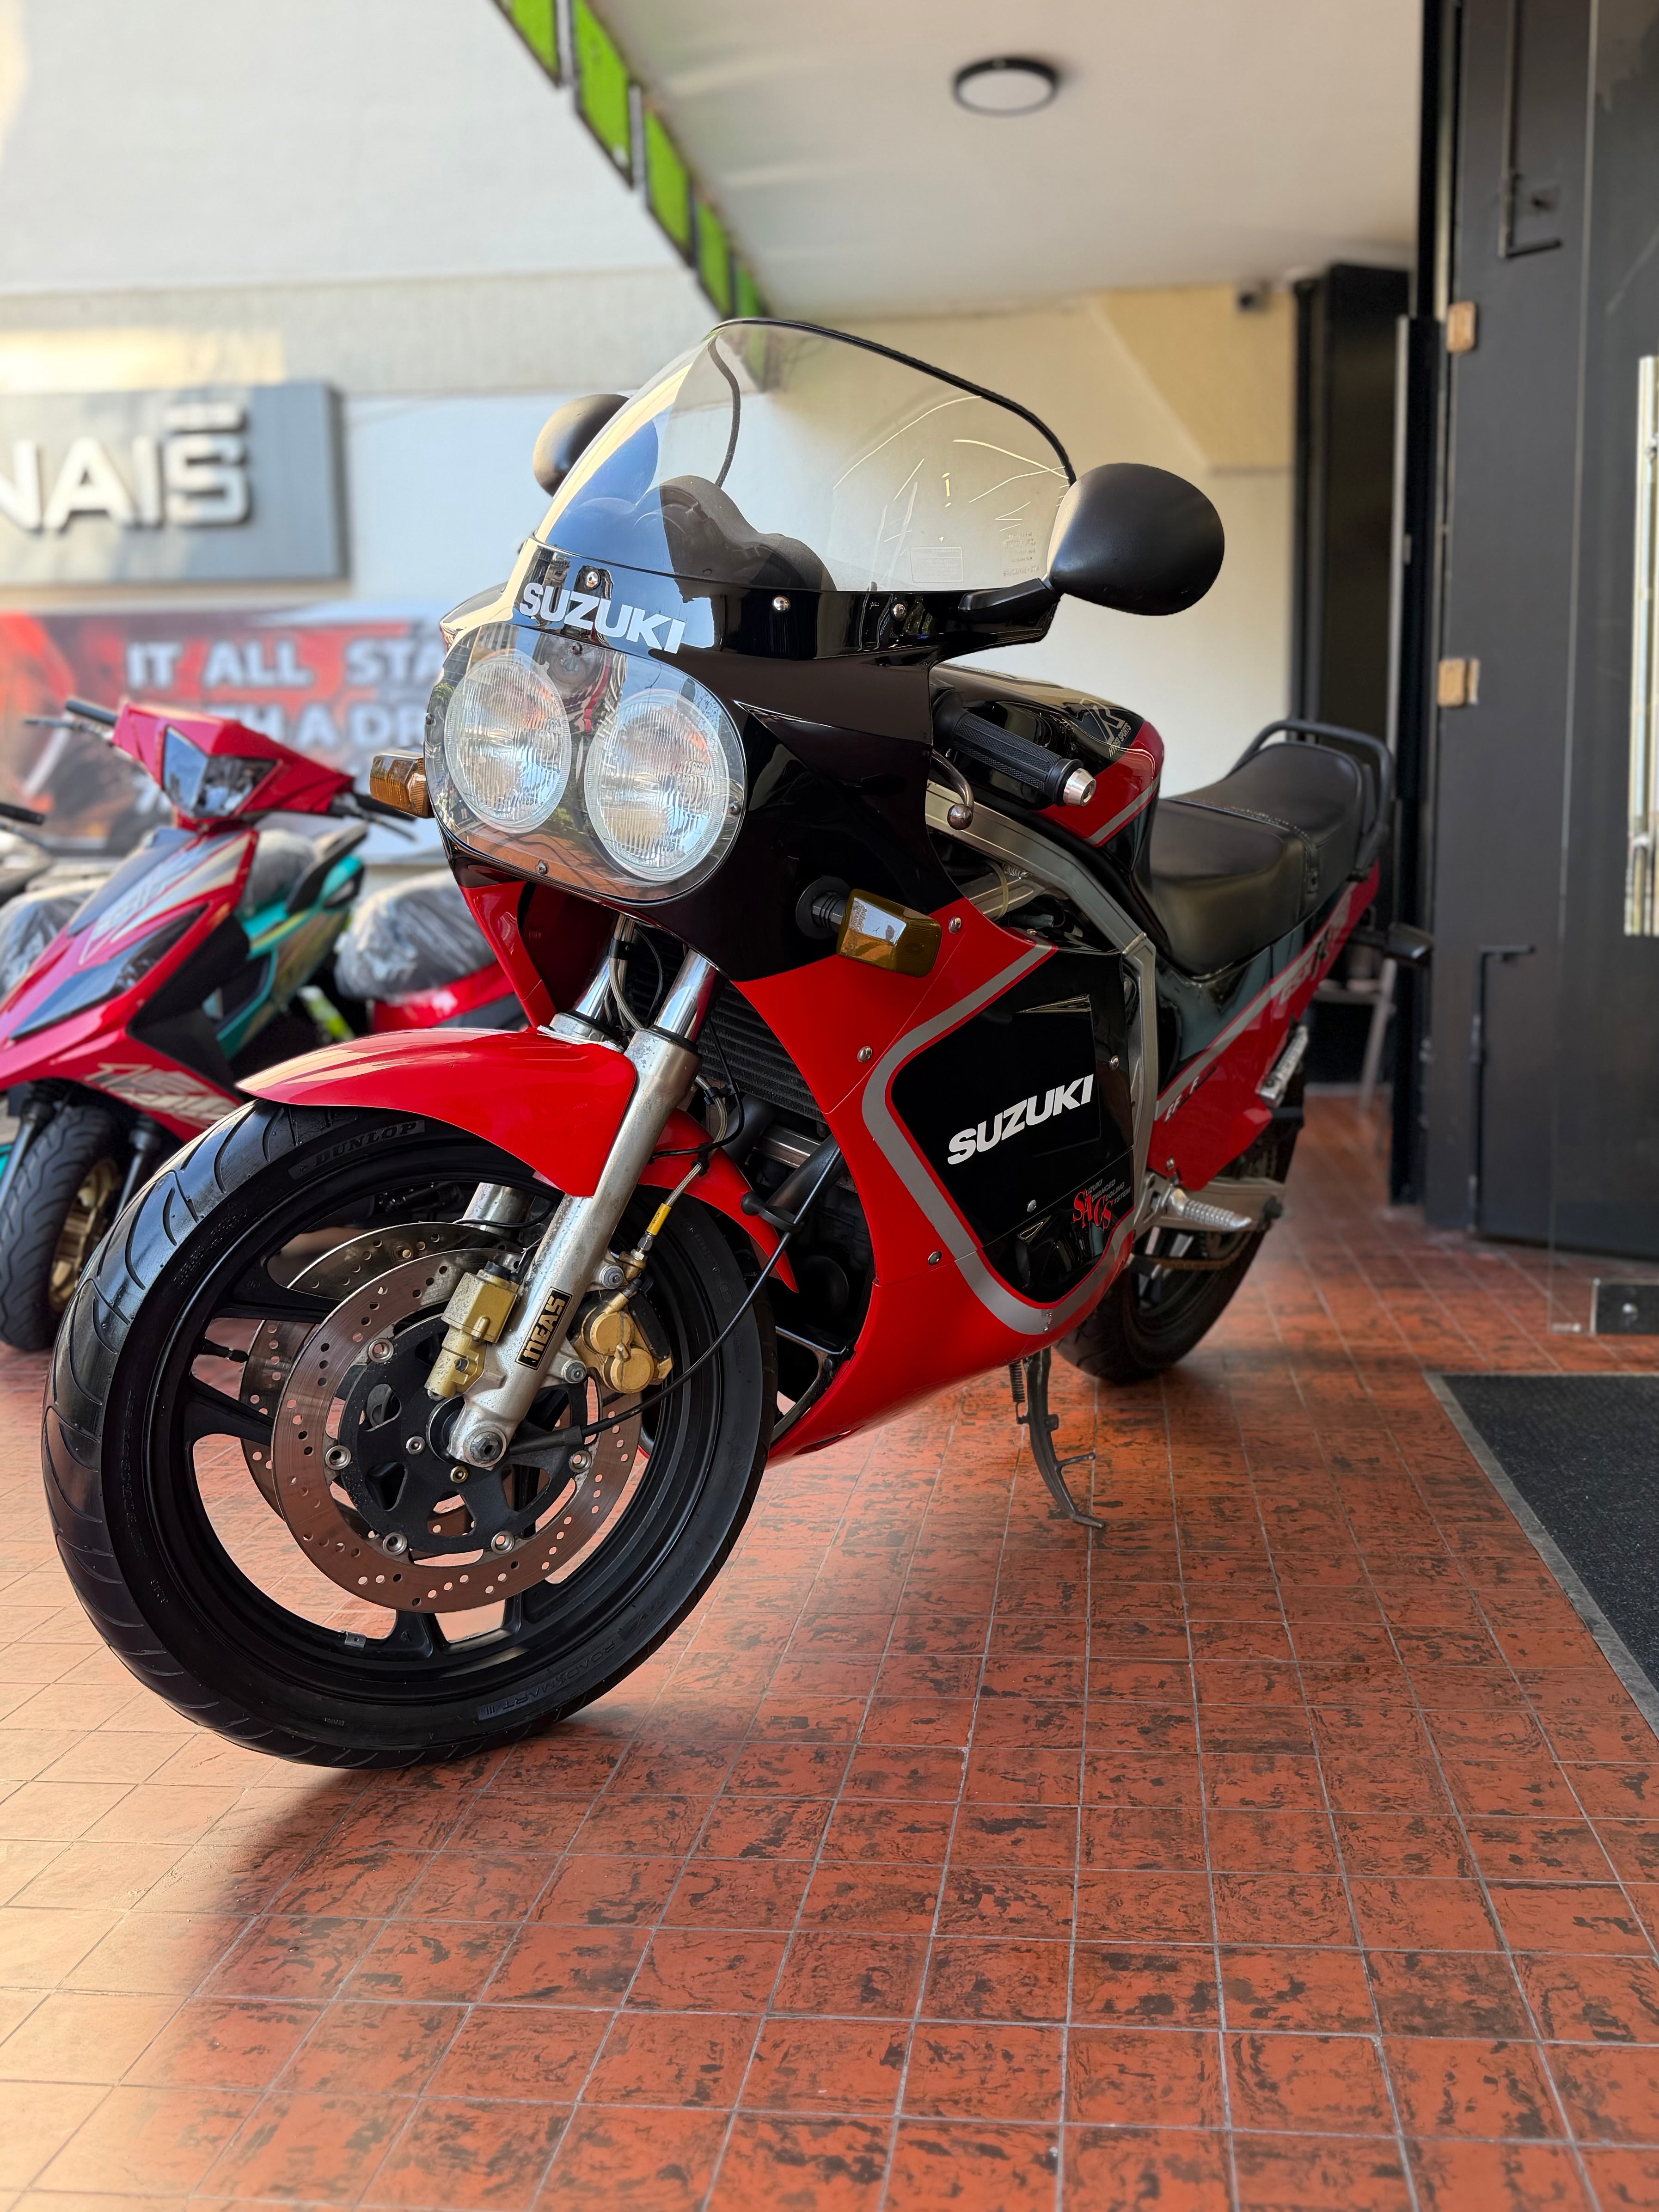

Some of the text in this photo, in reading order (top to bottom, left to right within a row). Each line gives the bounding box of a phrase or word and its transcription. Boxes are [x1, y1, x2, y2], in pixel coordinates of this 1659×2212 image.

[520, 582, 686, 654] SUZUKI
[125, 642, 180, 690] IT
[202, 639, 312, 689] ALL
[314, 1122, 417, 1166] DUNLOP
[948, 1074, 1094, 1164] SUZUKI
[503, 1640, 615, 1710] ROADSMART
